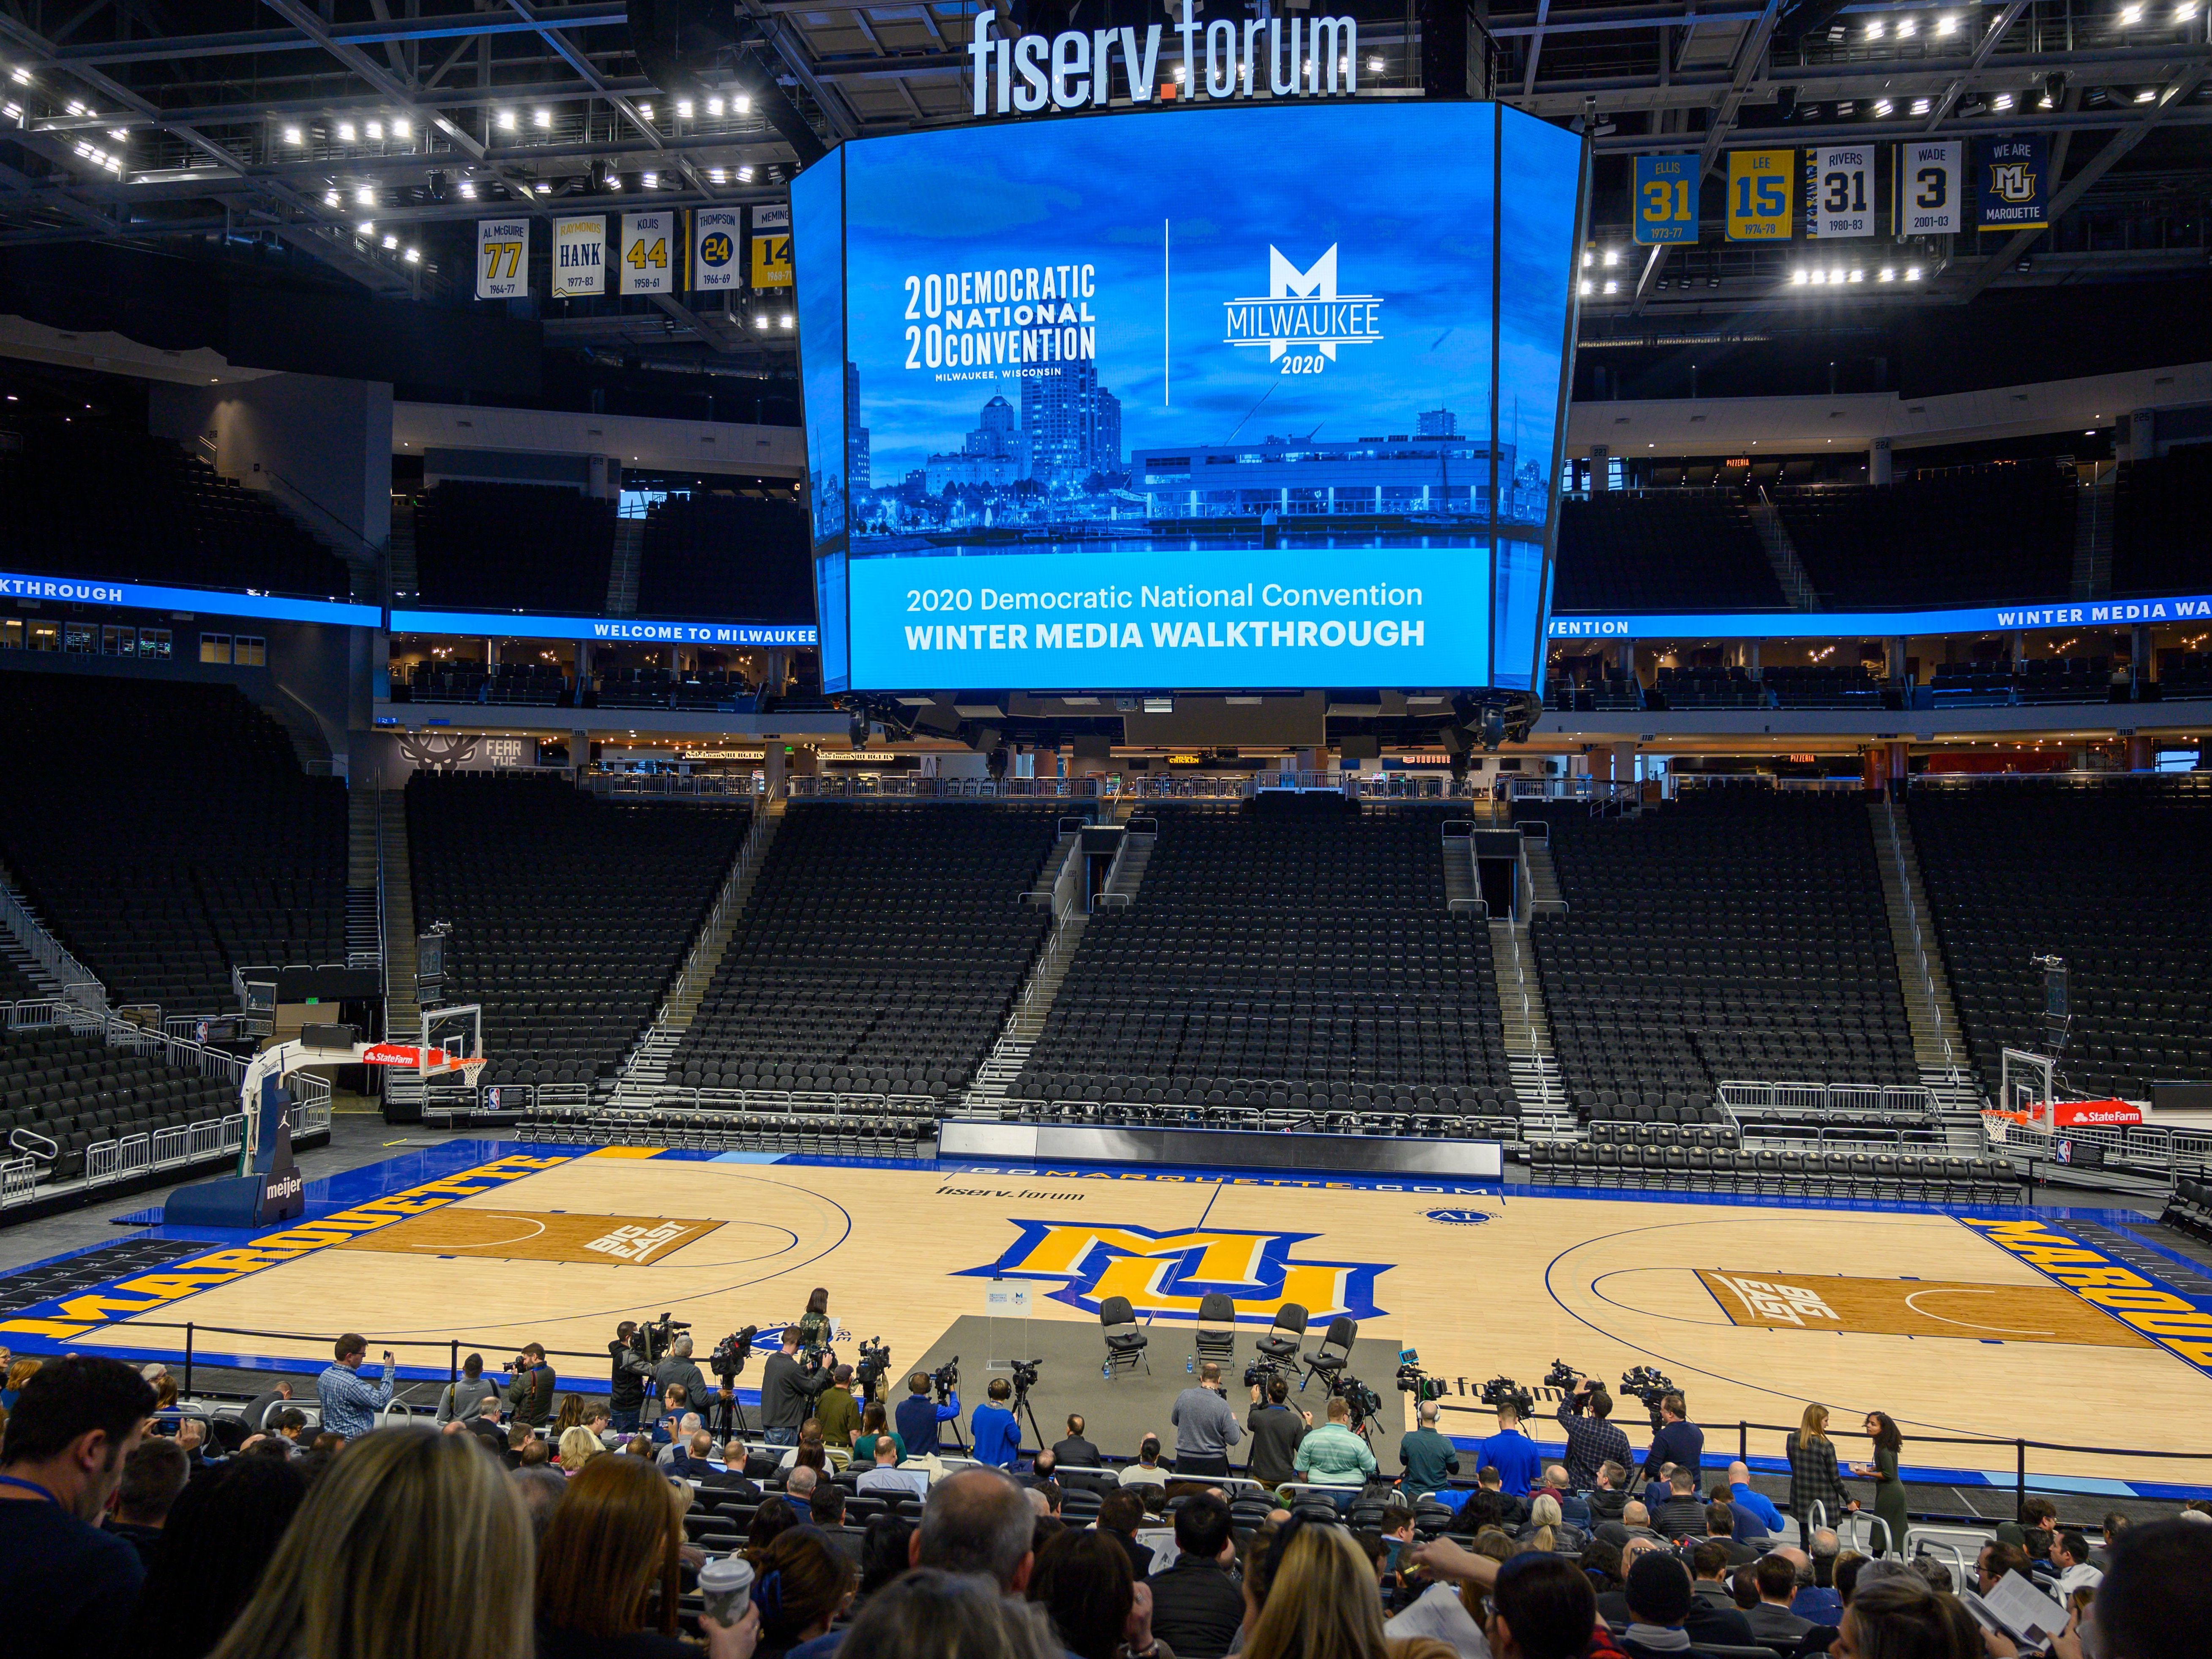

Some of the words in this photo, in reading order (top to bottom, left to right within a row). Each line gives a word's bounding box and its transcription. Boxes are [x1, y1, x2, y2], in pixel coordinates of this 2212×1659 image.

[1829, 153, 1862, 167] RIVERS
[1919, 149, 1946, 163] WADE
[1994, 145, 2009, 159] WE
[2011, 143, 2031, 157] ARE
[1655, 163, 1680, 175] ELLIS
[1753, 157, 1770, 169] LEE
[1735, 175, 1786, 218] 15
[1824, 171, 1867, 213] 31
[1916, 168, 1947, 209] 3
[1643, 180, 1691, 222] 31
[699, 214, 736, 227] THOMPSON
[1914, 215, 1949, 228] 2001-03
[1986, 206, 2040, 220] MARQUETTE
[483, 228, 492, 239] AL
[494, 225, 524, 238] McGUIRE
[560, 222, 601, 236] RAYMONDS
[637, 219, 658, 231] KOJIS
[1651, 227, 1682, 239] 1973-77
[1744, 222, 1775, 235] 1974-78
[1829, 219, 1863, 231] 1980-83
[560, 243, 601, 268] HANK
[627, 238, 667, 270] 44
[705, 238, 729, 261] 24
[763, 237, 791, 266] 14
[484, 242, 522, 279] 77
[567, 276, 593, 287] 1977-83
[634, 278, 660, 289] 1958-61
[704, 273, 731, 284] 1966-69
[946, 264, 1095, 306] DEMOCRATIC
[489, 284, 515, 295] 1964-77
[905, 274, 942, 320] 20
[946, 302, 1095, 330] NATIONAL
[1227, 304, 1380, 337] MILWAUKEE
[905, 324, 942, 369] 20
[945, 327, 1095, 367] CONVENTION
[1281, 355, 1324, 374] 2020
[935, 371, 998, 382] MILWAUKEE,
[1002, 367, 1062, 378] WISCONSIN
[1594, 448, 1606, 457] 223
[1726, 459, 1749, 467] PIZZERIA
[907, 588, 972, 612] 2020
[980, 586, 1132, 610] Democratic
[1140, 583, 1253, 609] National
[1261, 582, 1423, 607] Convention
[1998, 609, 2083, 626] WINTER
[2092, 604, 2166, 620] MEDIA
[594, 624, 683, 639] WELCOME
[688, 628, 711, 640] TO
[717, 629, 817, 642] MILWAUKEE
[905, 624, 1027, 650] WINTER
[1035, 623, 1144, 649] MEDIA
[1151, 620, 1425, 648] WALKTHROUGH
[486, 740, 522, 756] FEAR
[267, 1176, 301, 1200] meijer
[1432, 1212, 1486, 1221] AL
[583, 1224, 648, 1252] BIG
[607, 1221, 686, 1259] EAST
[972, 1221, 1378, 1323] MU
[1732, 1277, 1806, 1326] EAST
[1772, 1284, 1841, 1320] BIG
